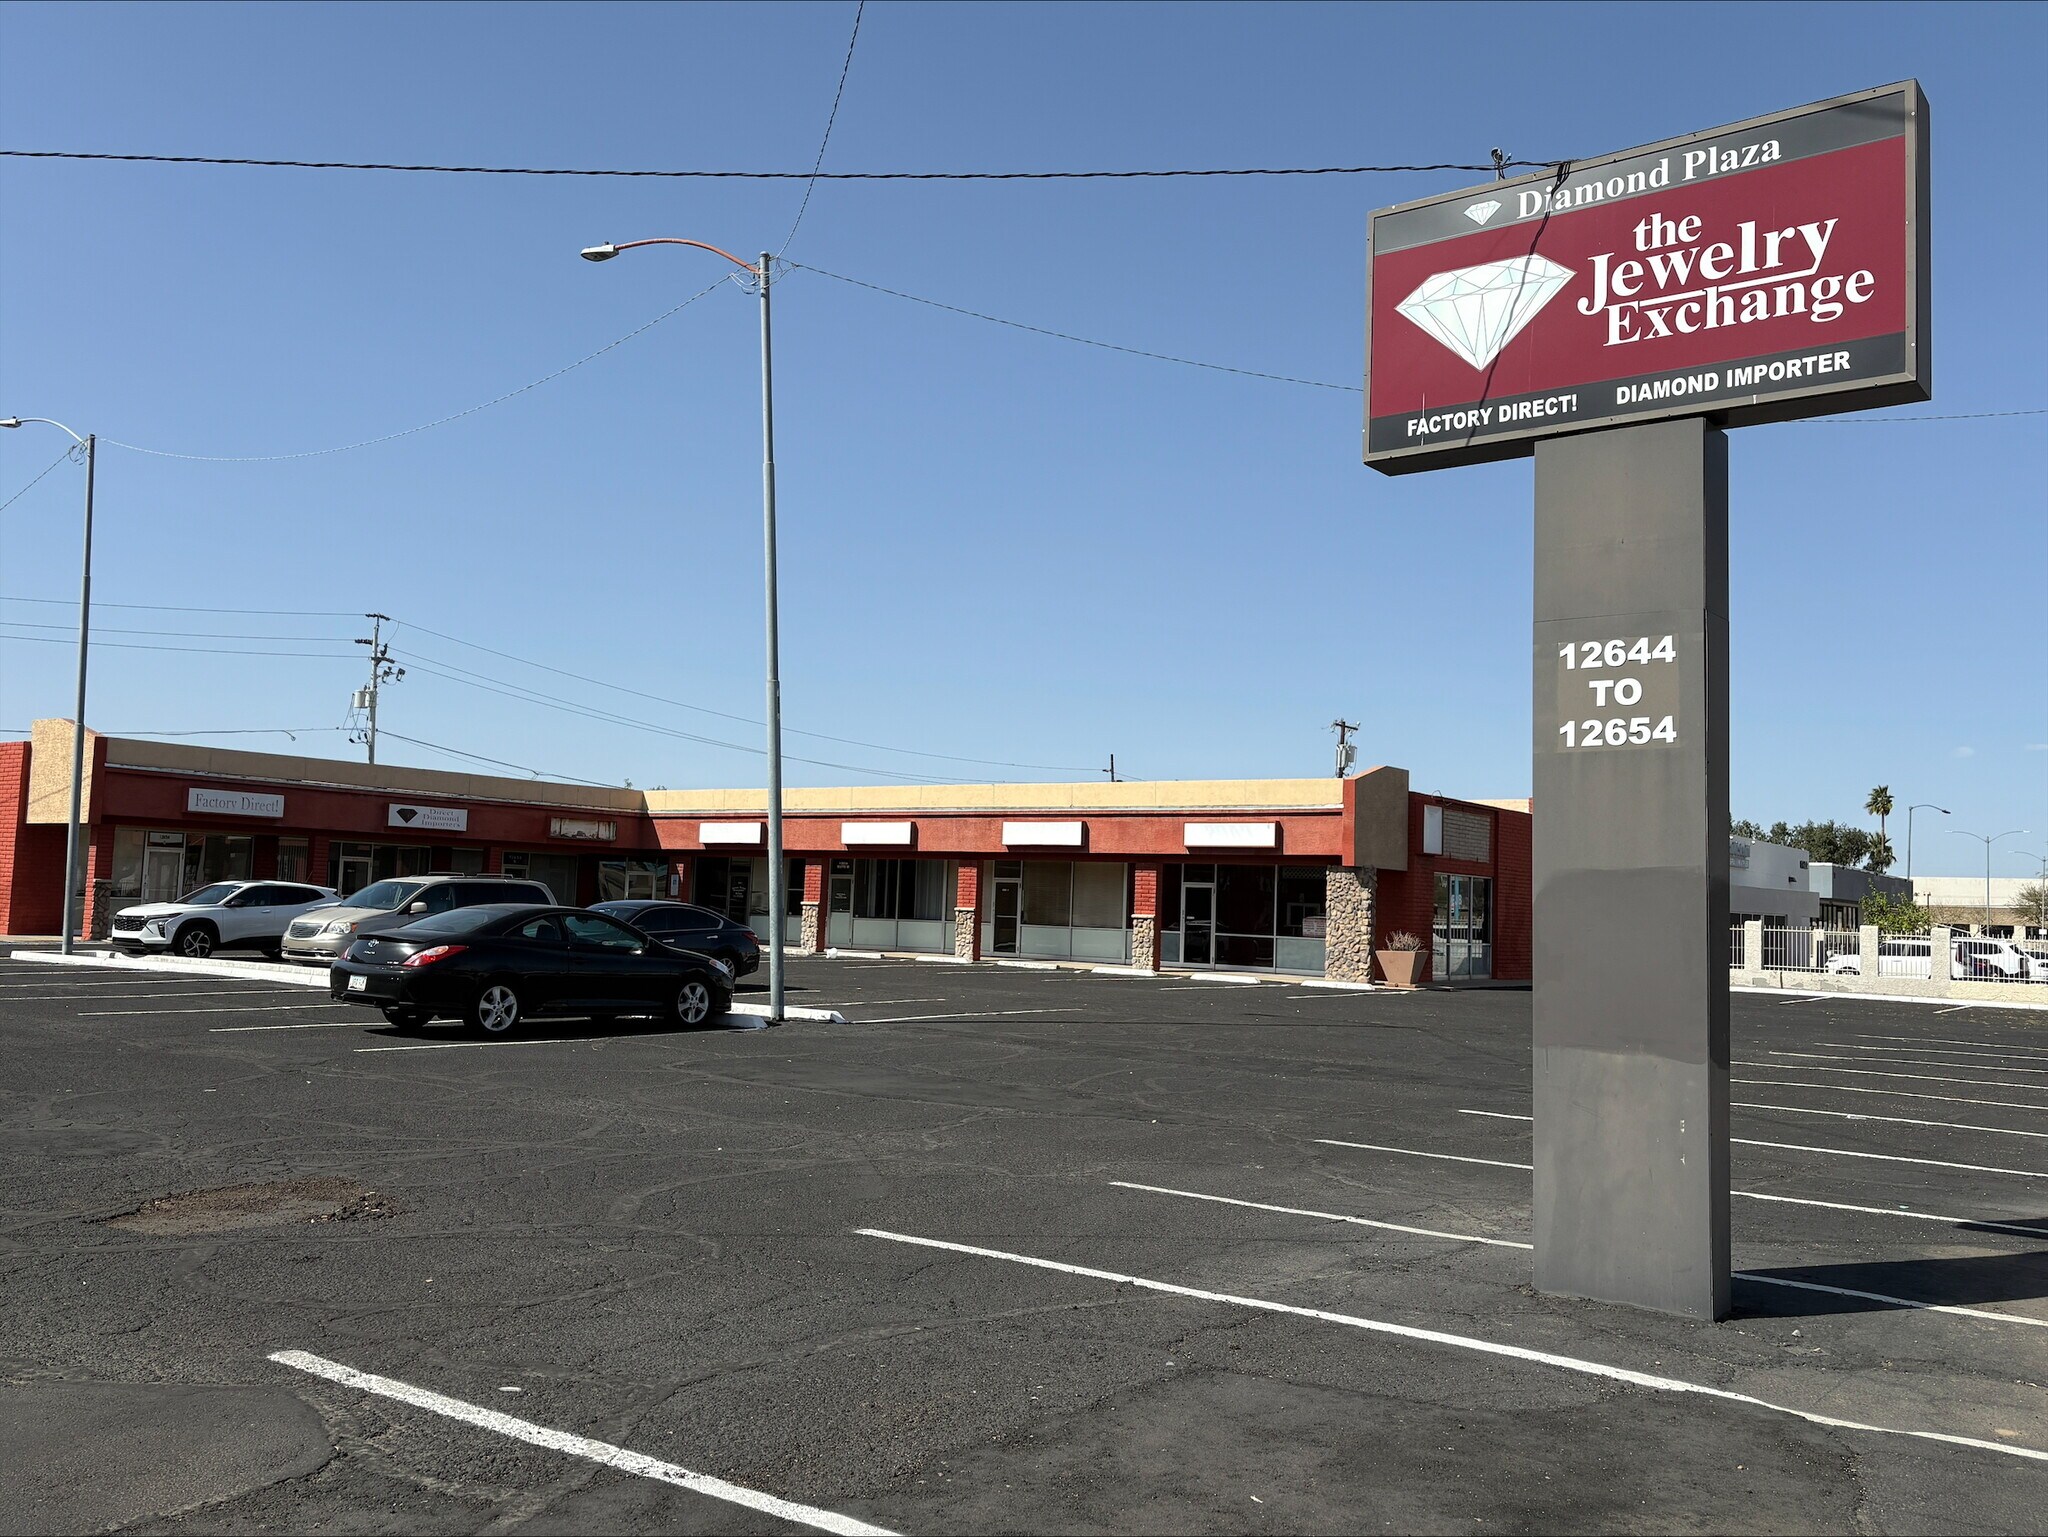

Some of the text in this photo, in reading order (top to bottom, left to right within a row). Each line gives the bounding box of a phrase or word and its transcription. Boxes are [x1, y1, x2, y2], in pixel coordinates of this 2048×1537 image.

[1516, 139, 1782, 220] Diamond Plaza
[1632, 212, 1702, 252] the
[1576, 217, 1839, 316] Jewelry
[1603, 268, 1875, 347] Exchange
[1616, 350, 1851, 405] DIAMOND IMPORTER
[1407, 393, 1578, 437] FACTORY DIRECT!
[1559, 635, 1677, 670] 12644
[1588, 677, 1643, 707] TO
[1559, 715, 1678, 748] 12654
[195, 793, 279, 812] Factory Direct!
[423, 813, 460, 823] Diamond
[429, 808, 454, 816] Direct
